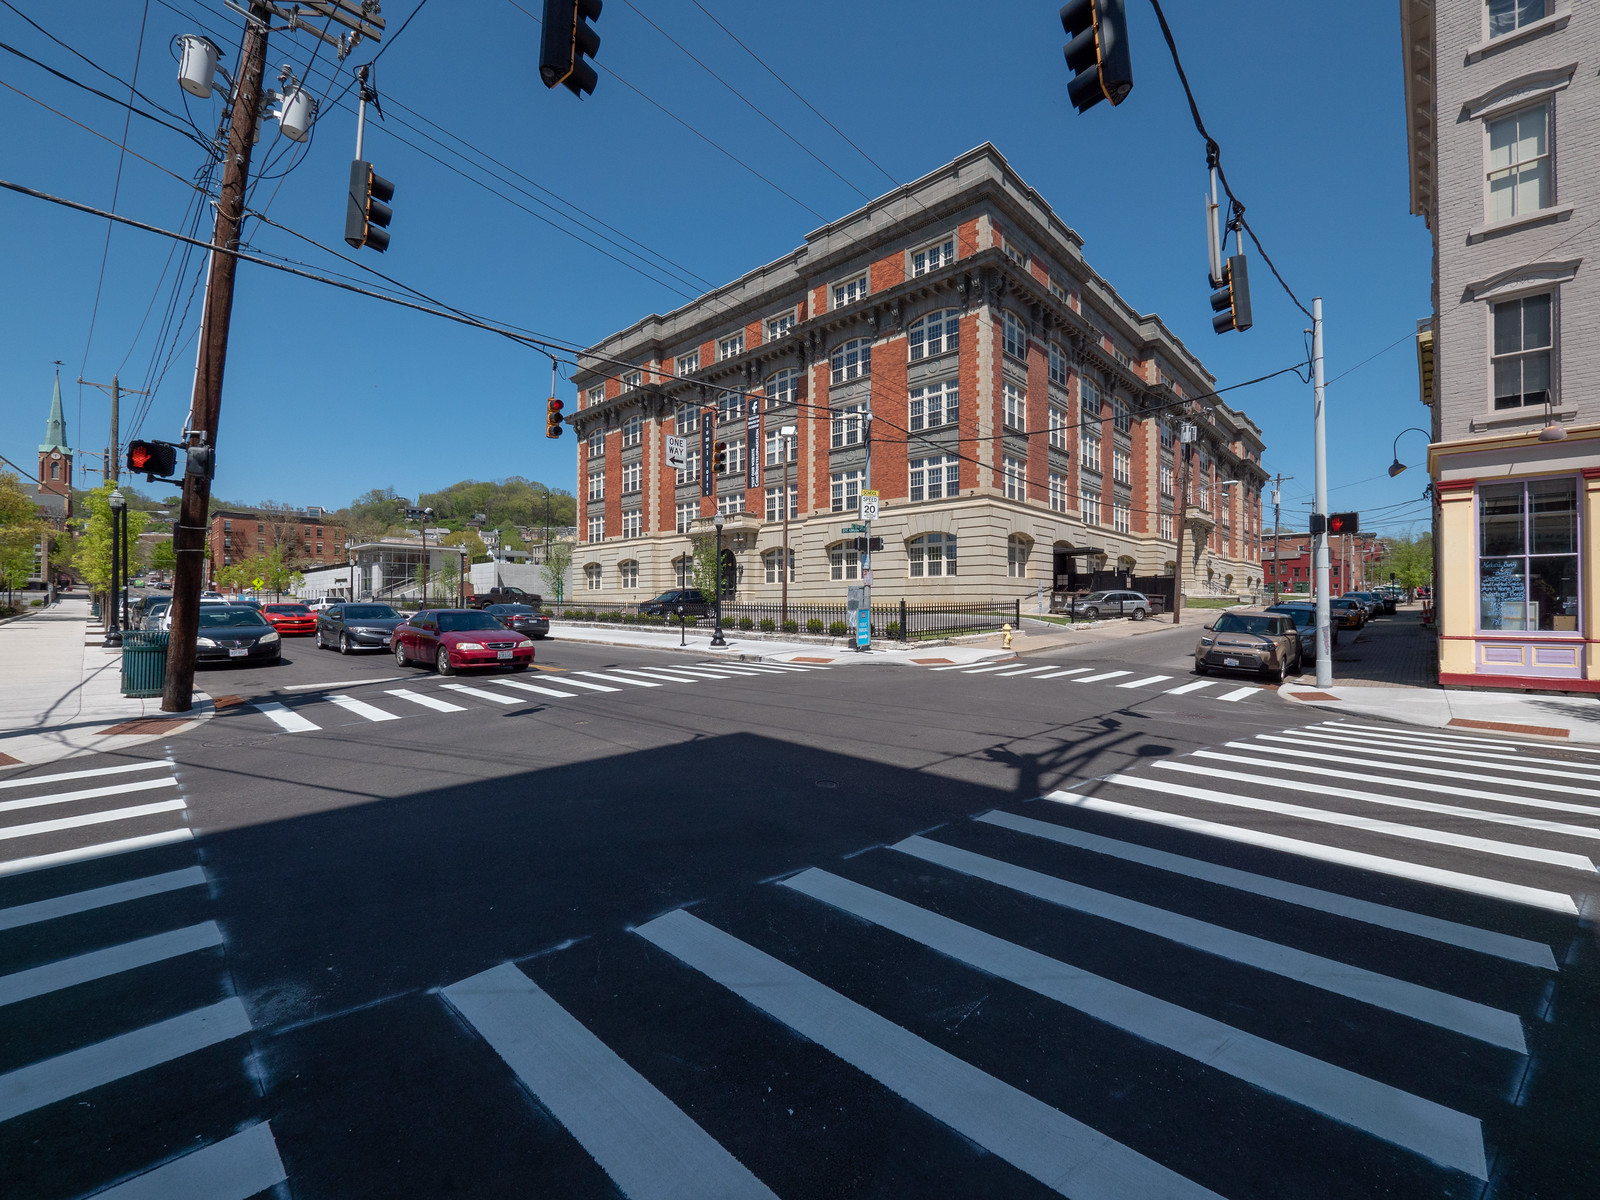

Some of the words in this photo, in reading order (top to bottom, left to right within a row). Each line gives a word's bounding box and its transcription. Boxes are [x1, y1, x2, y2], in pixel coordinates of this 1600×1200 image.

[669, 438, 683, 447] ONE
[669, 446, 684, 456] WAY
[864, 505, 875, 513] 20
